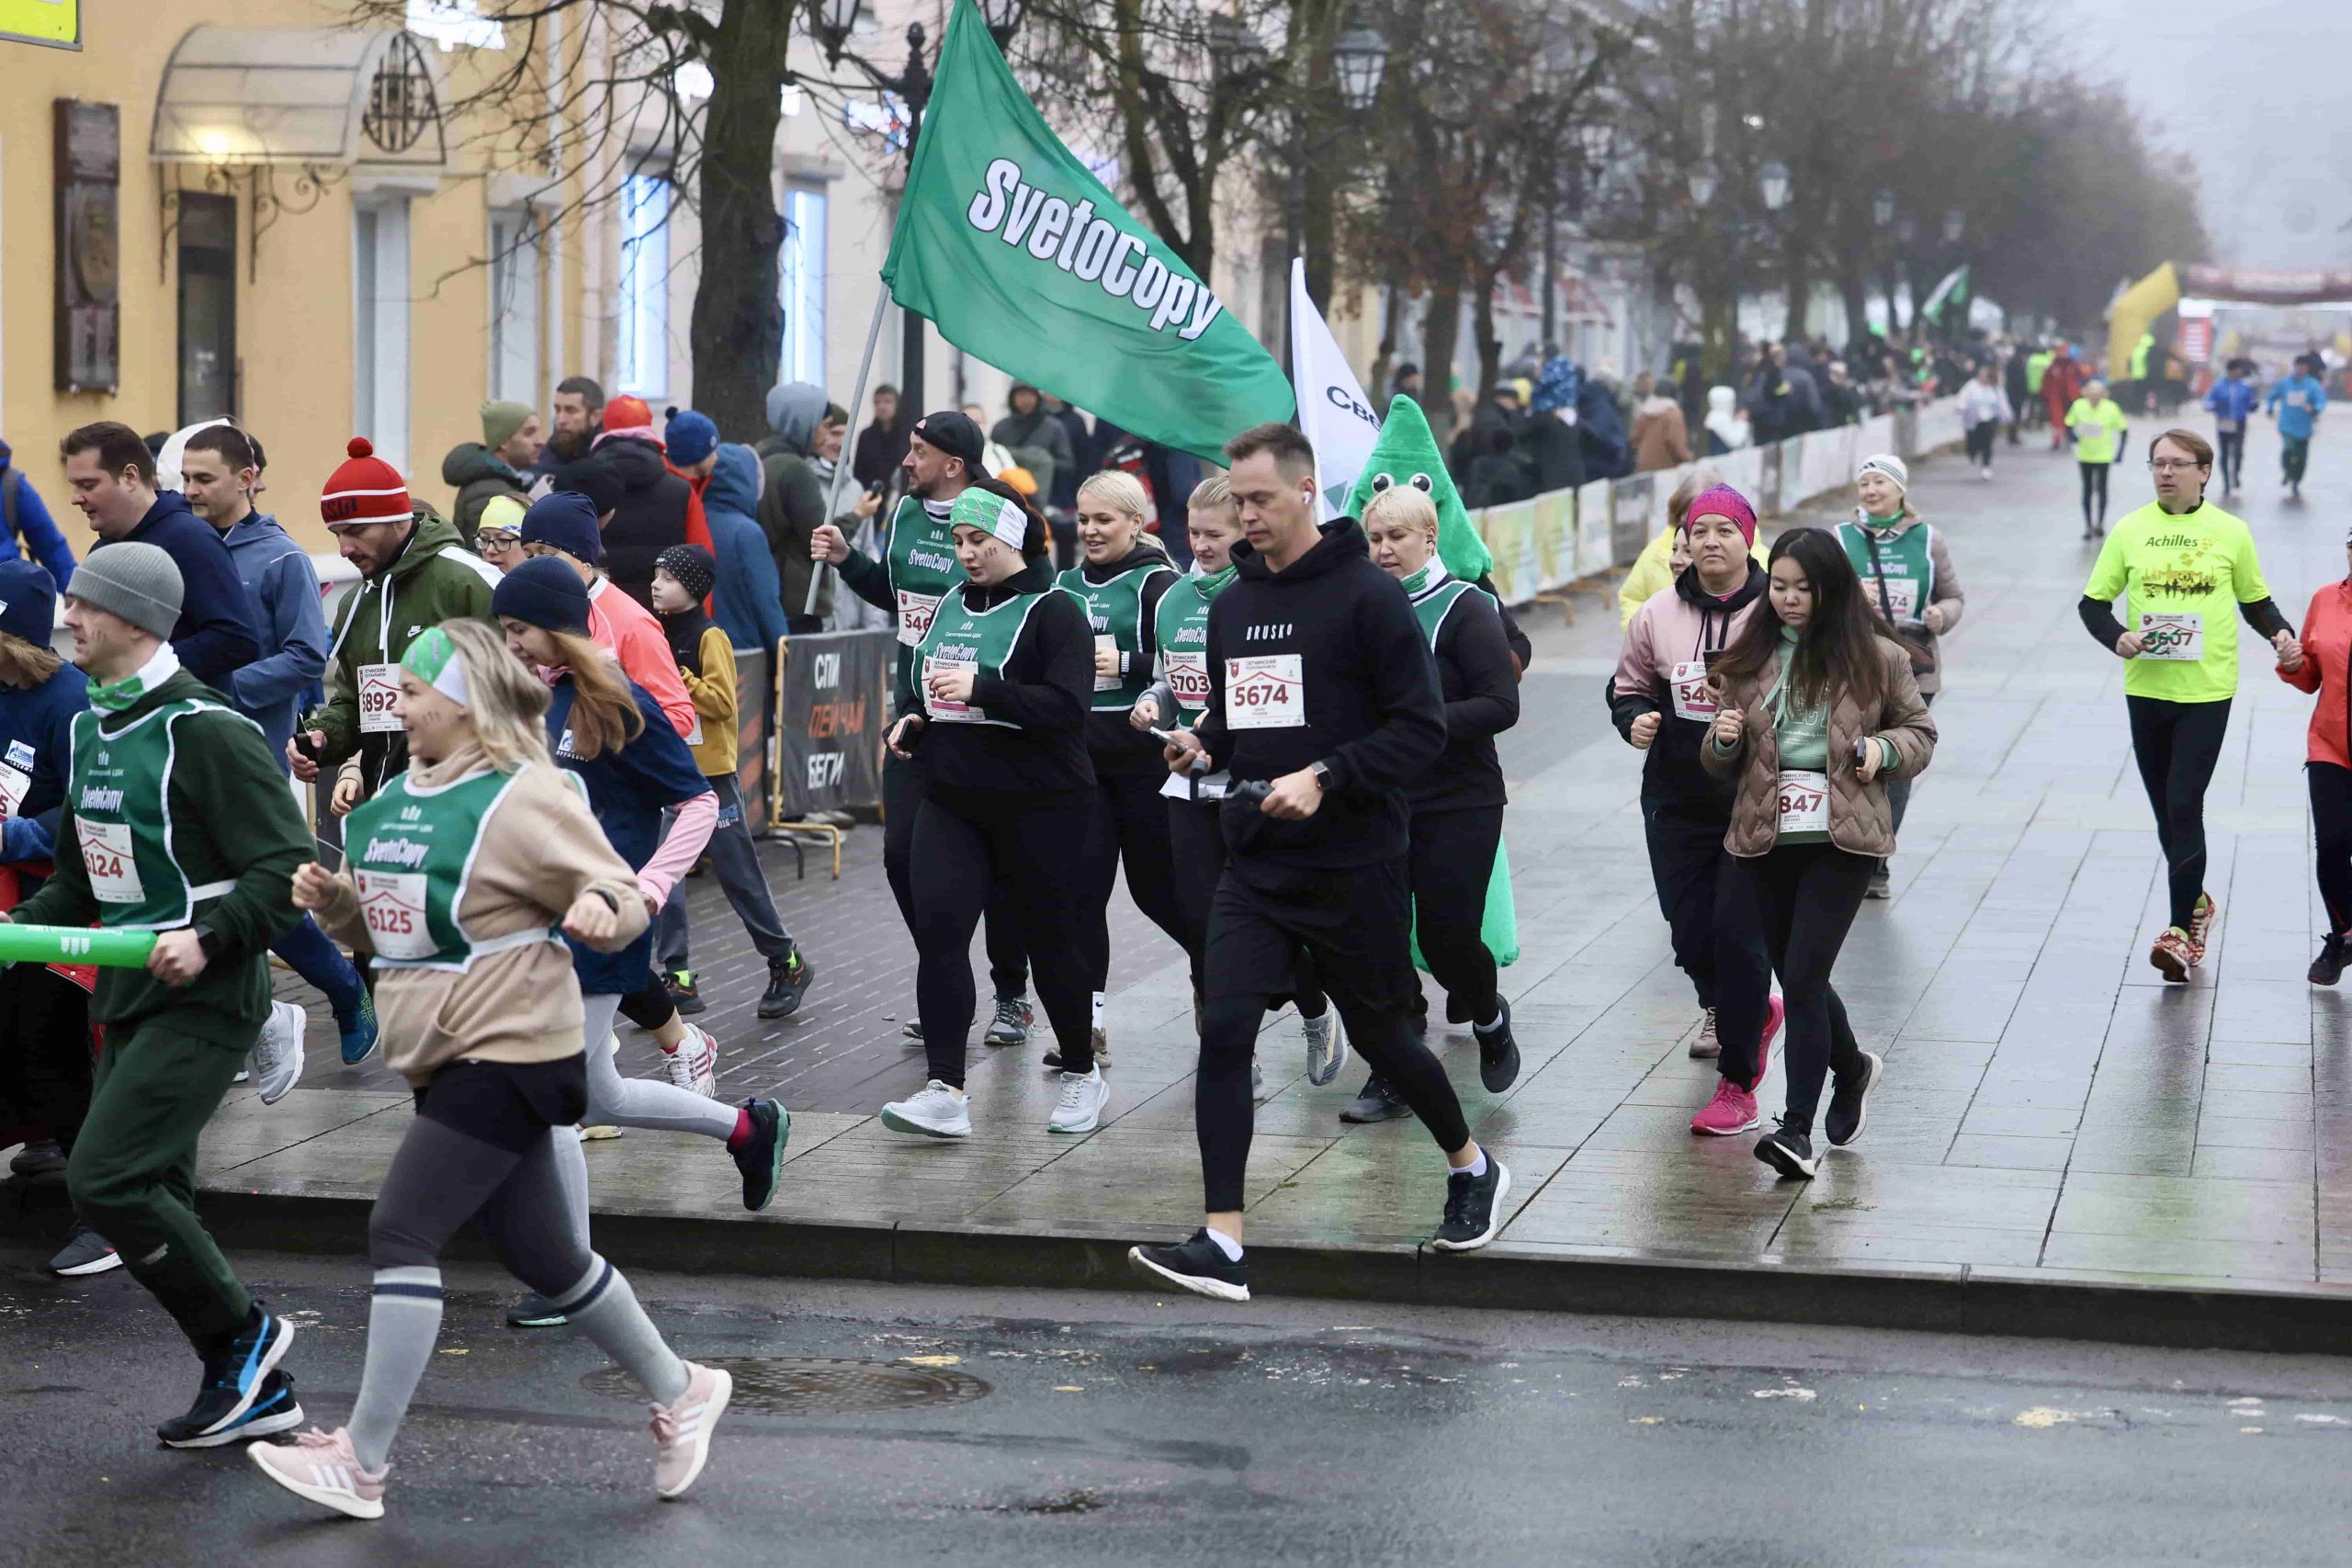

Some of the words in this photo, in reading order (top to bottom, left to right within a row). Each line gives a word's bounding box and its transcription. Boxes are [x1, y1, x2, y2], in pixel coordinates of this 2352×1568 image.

[967, 156, 1224, 341] SvetoCopy
[2144, 535, 2199, 547] Achilles
[908, 548, 955, 574] SvetoCopy
[905, 613, 931, 631] 546
[1246, 623, 1294, 641] BRUSKO
[933, 641, 979, 661] SvetoCopy
[814, 652, 842, 691] СПИ
[1170, 673, 1210, 693] 5703
[1234, 683, 1289, 707] 5674
[1679, 684, 1706, 704] 54
[808, 751, 846, 790] БЕГИ
[80, 784, 125, 814] SvetoCopy
[1779, 794, 1823, 814] 847
[84, 850, 124, 879] 6124
[364, 837, 430, 870] SvetoCopy
[368, 905, 413, 935] 6125
